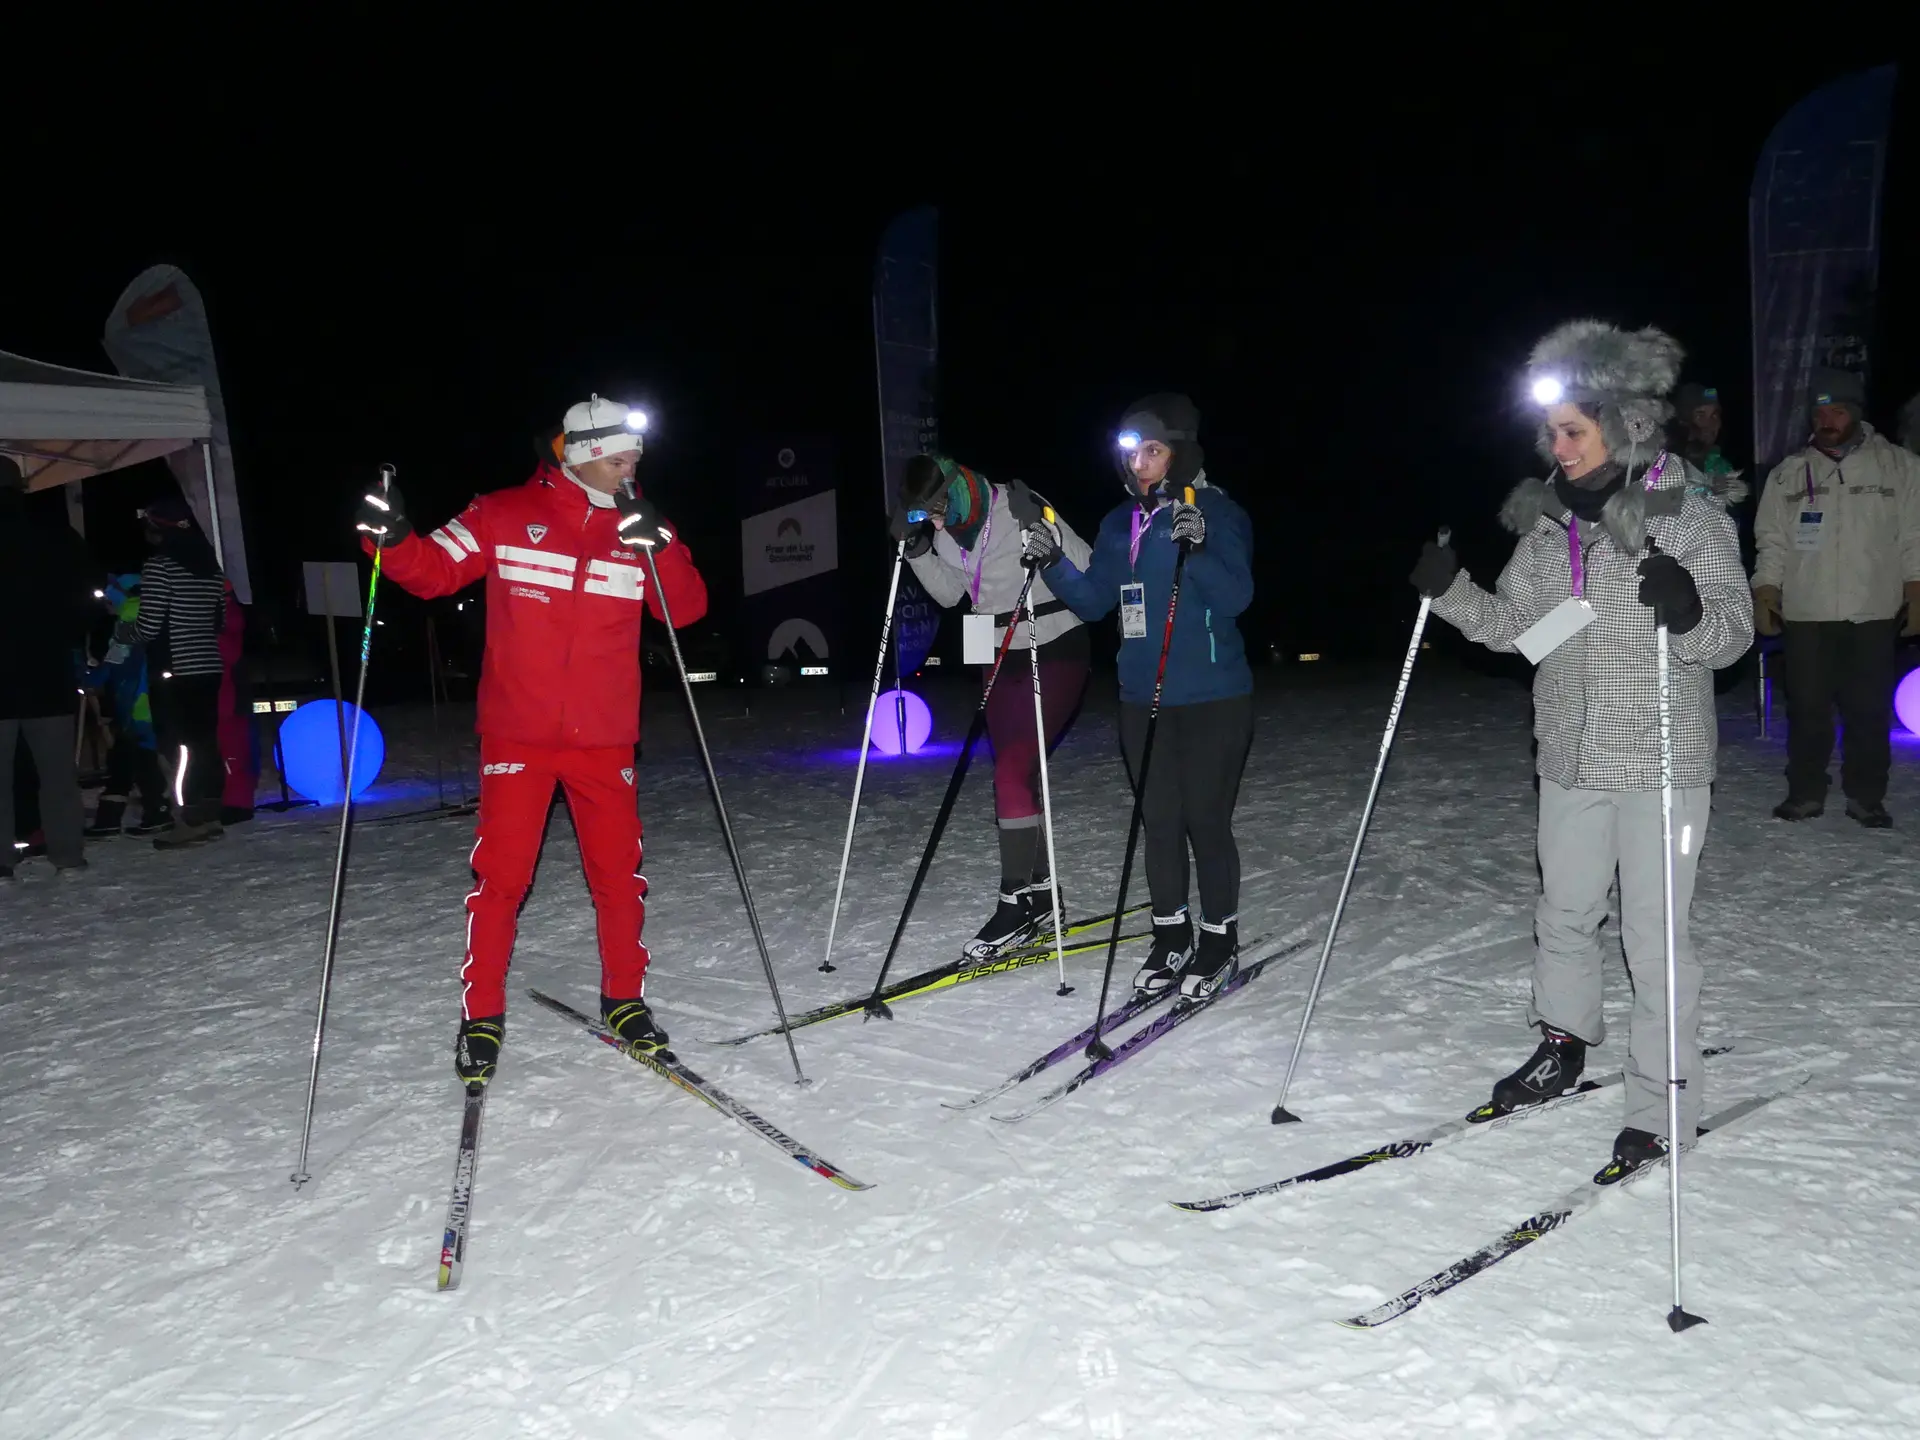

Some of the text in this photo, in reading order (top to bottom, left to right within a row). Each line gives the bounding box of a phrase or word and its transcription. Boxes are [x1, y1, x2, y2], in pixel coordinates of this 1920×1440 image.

[872, 615, 892, 695] FISCHER
[1027, 610, 1042, 696] FISCHER
[1385, 647, 1418, 732] Quechua
[1659, 684, 1673, 790] Quechua
[956, 952, 1051, 984] FISCHER
[619, 1043, 671, 1079] SALOMON
